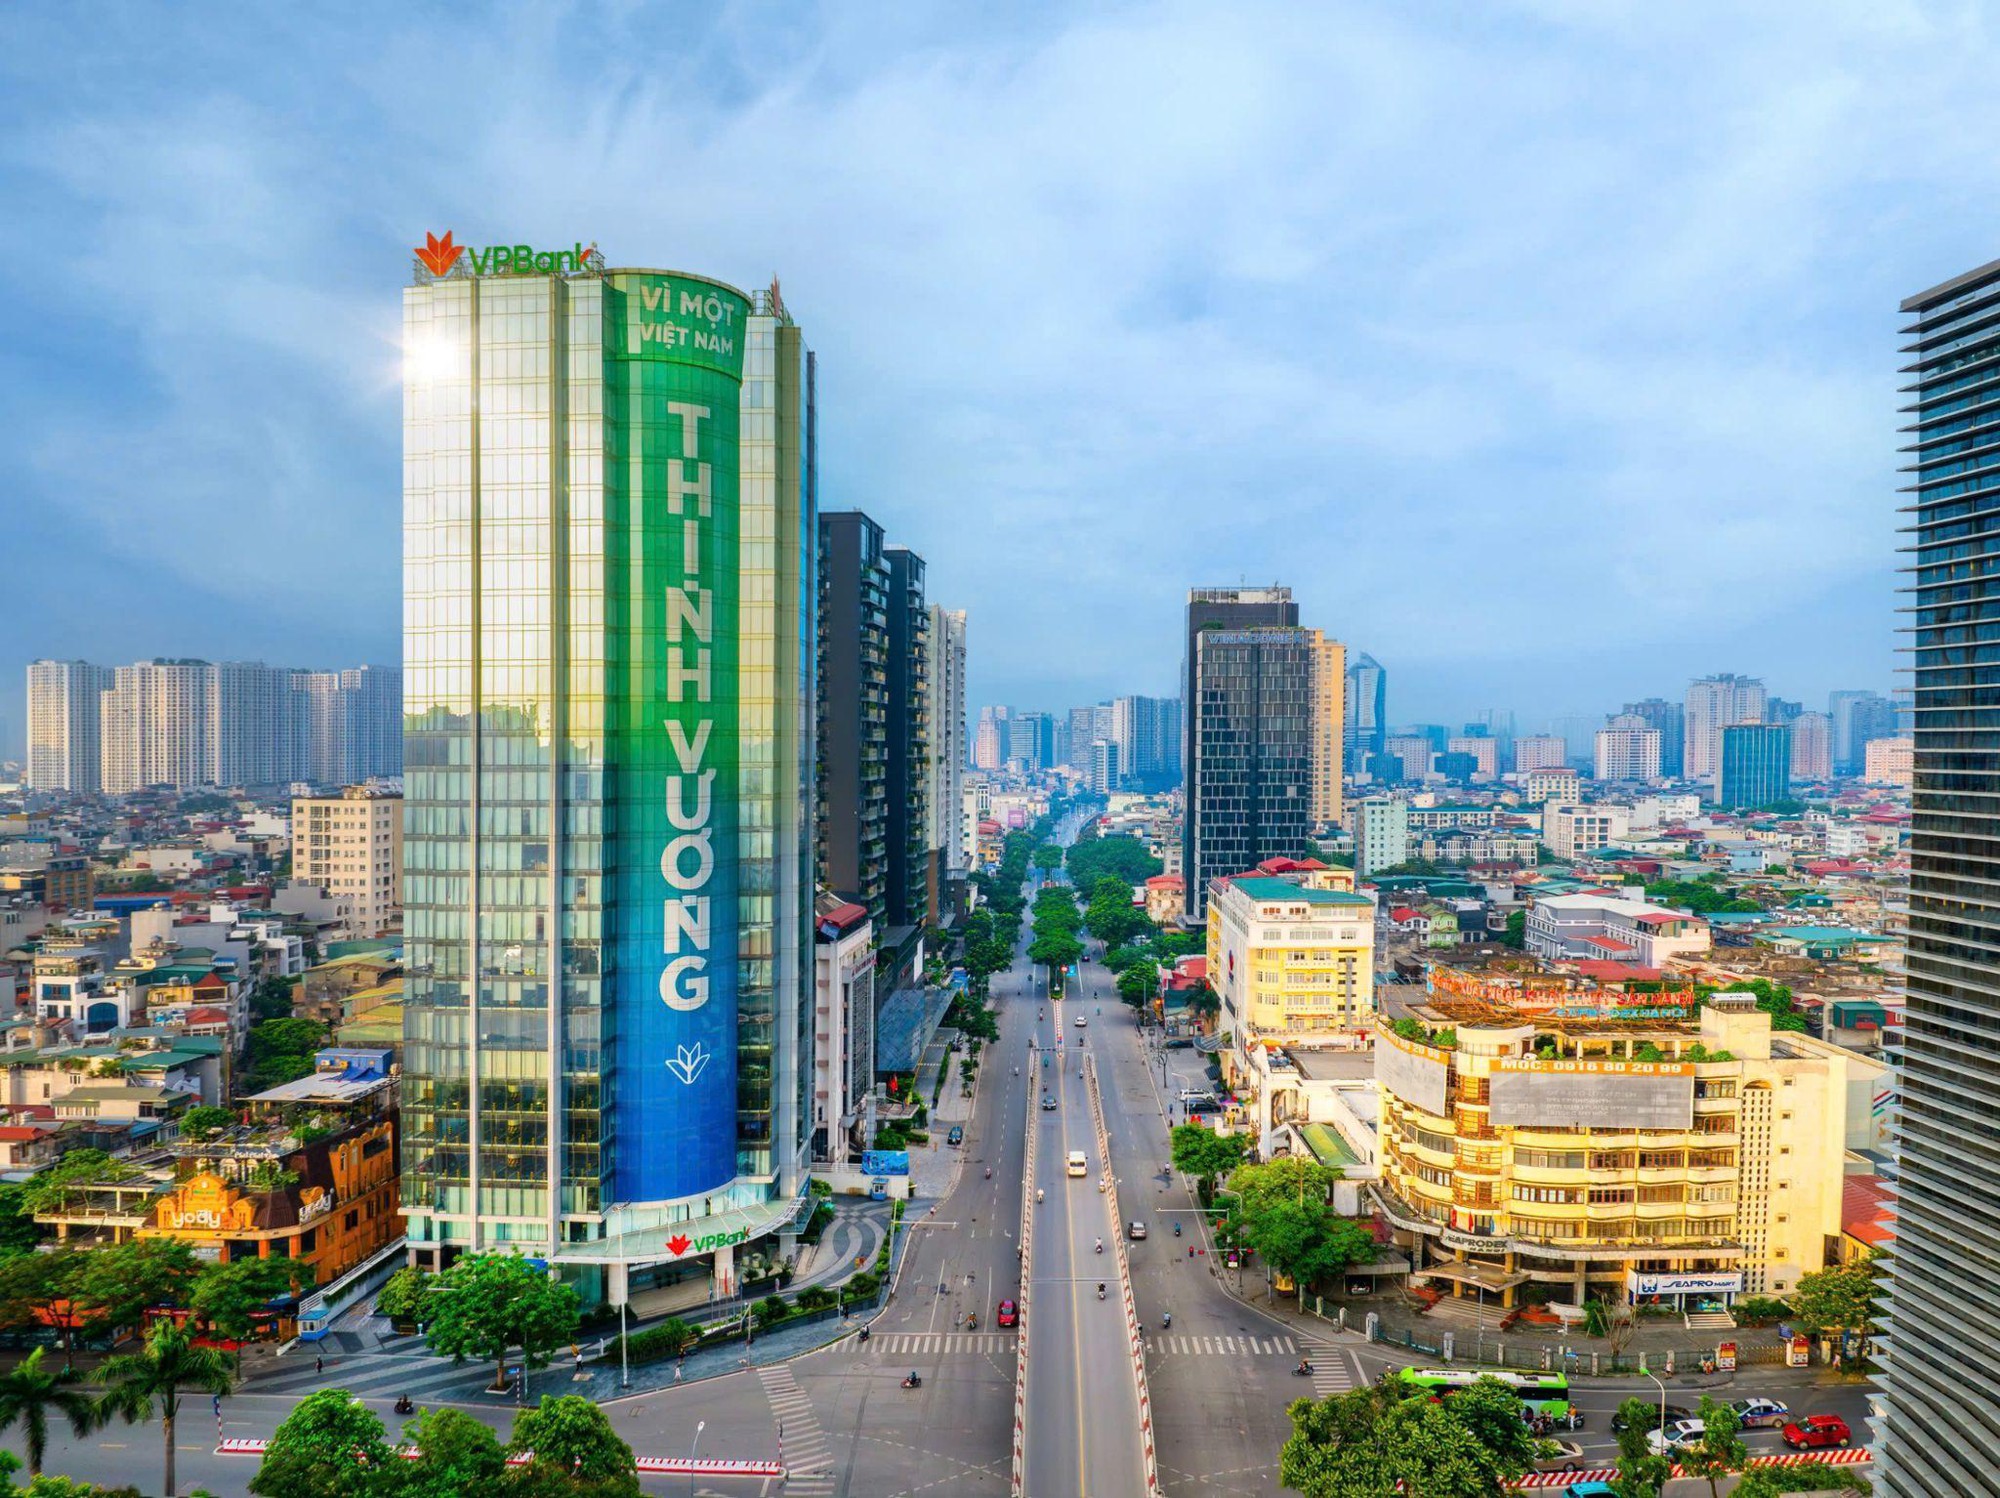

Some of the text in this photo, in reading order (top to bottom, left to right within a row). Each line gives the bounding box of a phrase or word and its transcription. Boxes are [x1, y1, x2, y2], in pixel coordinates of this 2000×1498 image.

[468, 242, 591, 275] VPBank
[640, 281, 735, 329] VÌ MỘT
[640, 320, 733, 357] VIỆT NAM
[1631, 1063, 1654, 1073] 20
[693, 1225, 751, 1252] VPBank
[1662, 1280, 1713, 1288] SEAPRO
